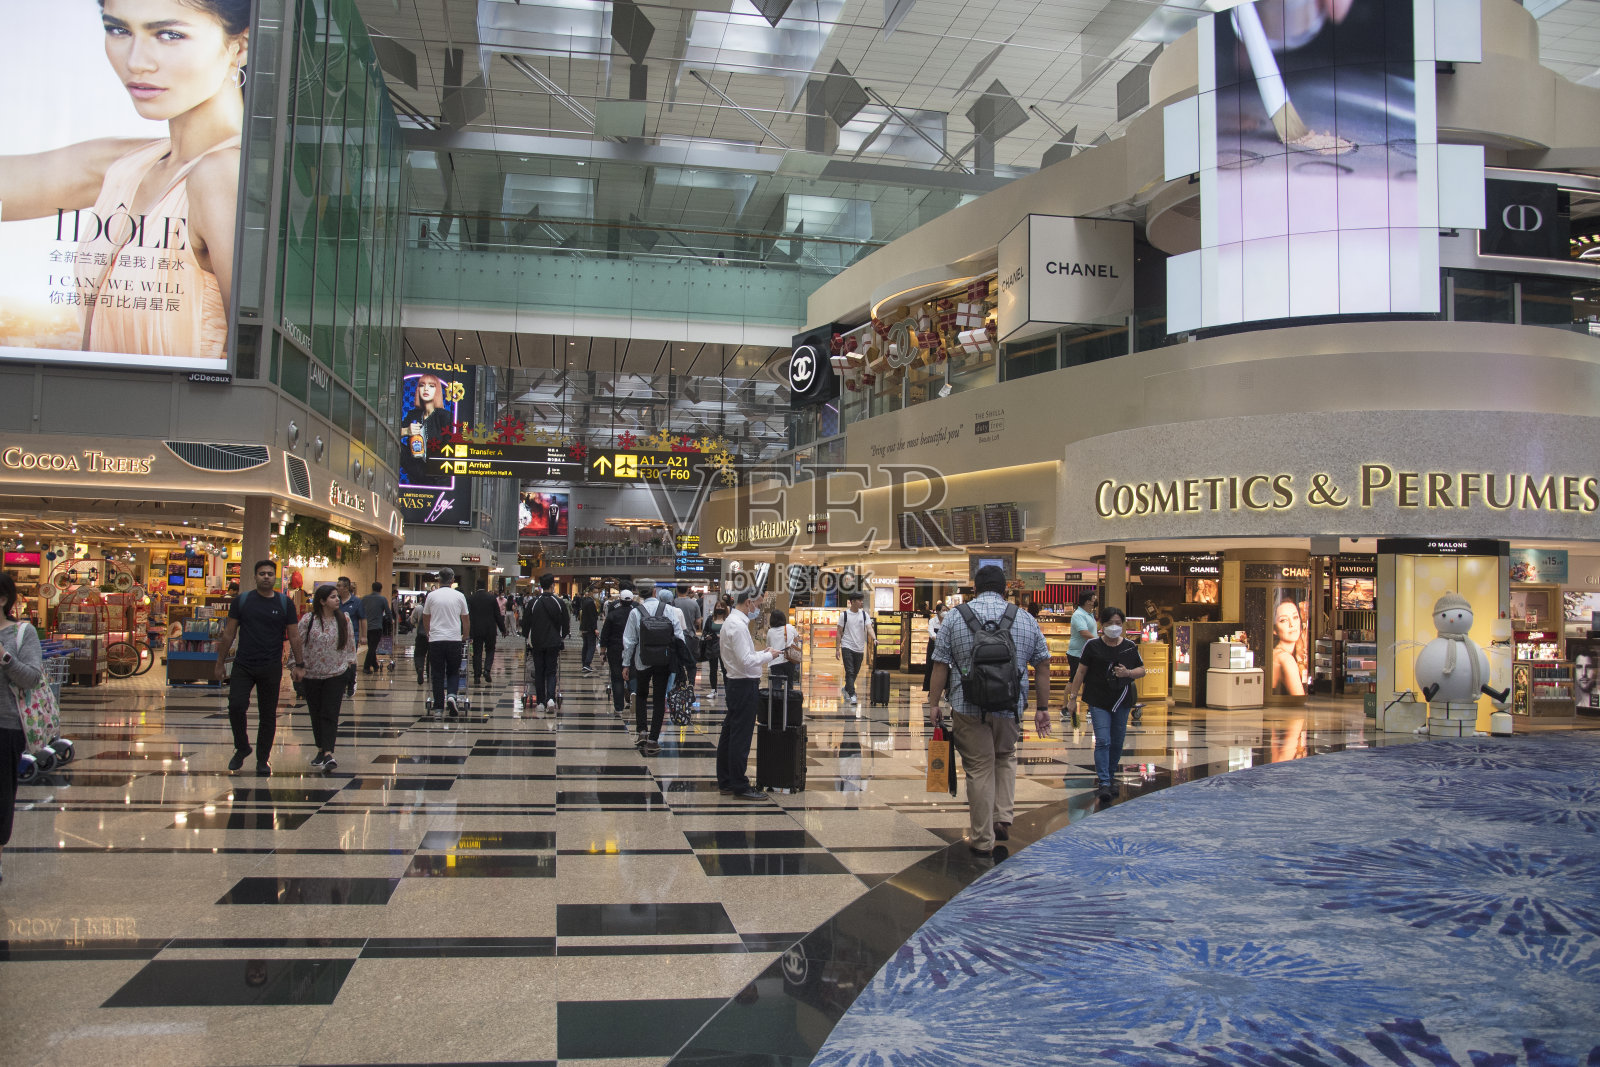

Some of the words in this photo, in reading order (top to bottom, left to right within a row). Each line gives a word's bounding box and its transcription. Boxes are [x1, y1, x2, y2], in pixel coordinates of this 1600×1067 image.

[54, 202, 187, 250] IDÔLE
[1046, 261, 1119, 278] CHANEL
[108, 279, 134, 291] WE
[141, 281, 184, 295] WILL
[1001, 265, 1025, 293] CHANEL
[189, 373, 230, 383] JCDecaux
[640, 456, 655, 466] A1
[666, 457, 688, 467] A21
[640, 469, 659, 479] F30
[670, 470, 690, 480] F60
[1095, 474, 1295, 518] COSMETICS
[1307, 473, 1349, 507] &
[871, 577, 898, 585] CLINIQUE
